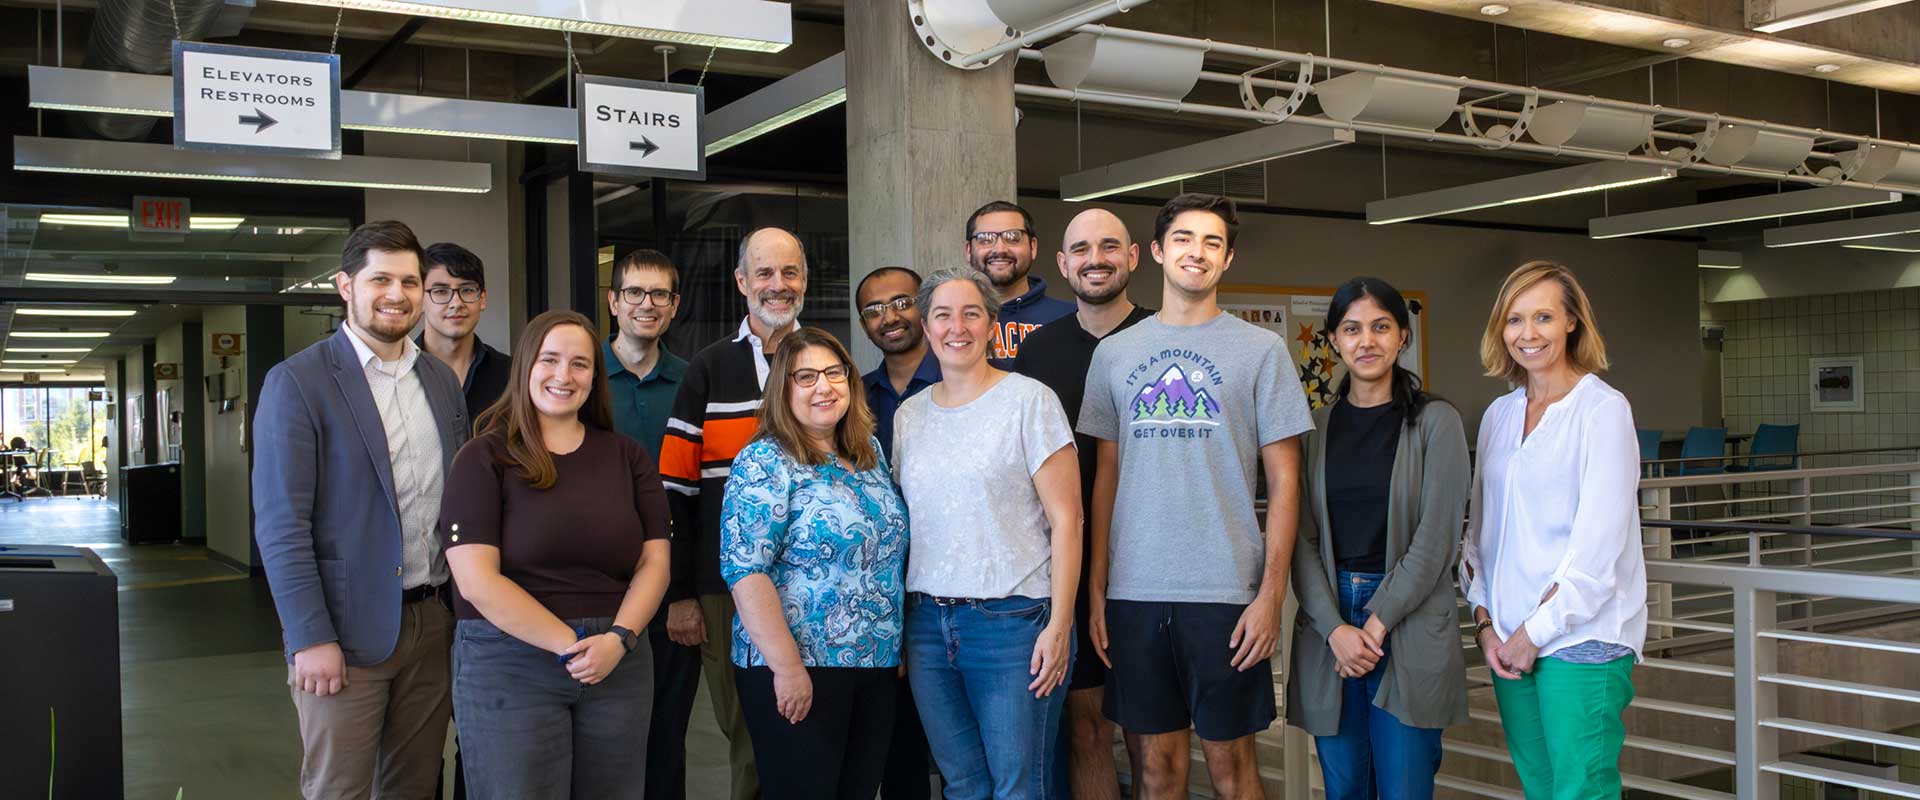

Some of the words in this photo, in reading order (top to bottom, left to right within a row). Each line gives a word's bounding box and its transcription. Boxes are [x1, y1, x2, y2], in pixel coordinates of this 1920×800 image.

[142, 200, 182, 229] EXIT
[1126, 362, 1147, 386] IT'S
[1149, 355, 1158, 366] A
[1160, 348, 1223, 386] MOUNTAIN
[1133, 427, 1156, 439] GET
[1160, 428, 1195, 438] OVER
[1198, 428, 1212, 438] IT
